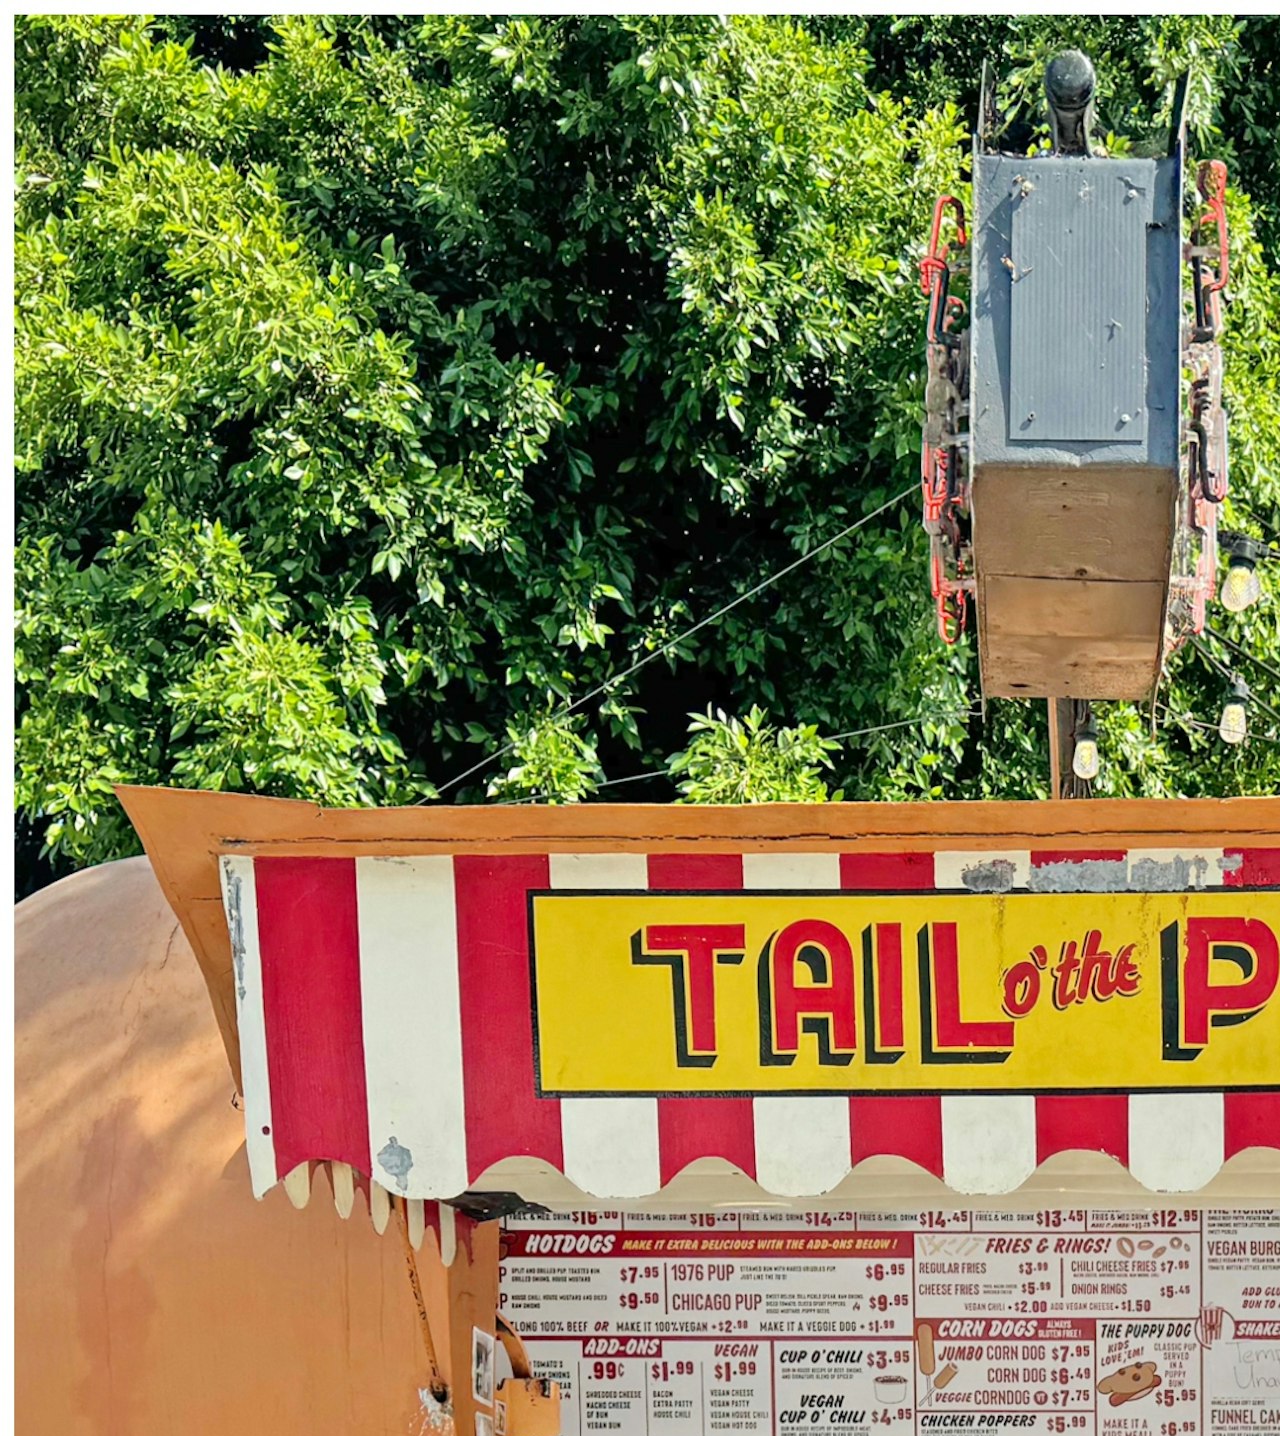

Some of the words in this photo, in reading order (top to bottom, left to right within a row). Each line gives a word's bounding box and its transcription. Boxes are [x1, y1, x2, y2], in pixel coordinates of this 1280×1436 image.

[631, 919, 1014, 1068] TAIL
[920, 1211, 968, 1228] $14.45
[1037, 1211, 1083, 1227] $13.45
[1153, 1210, 1198, 1227] $12.95
[525, 1234, 616, 1254] HOTDOGS
[623, 1240, 652, 1250] MAKE
[654, 1240, 665, 1249] IT
[667, 1240, 698, 1250] EXTRA
[701, 1240, 755, 1250] DELICIOUS
[757, 1240, 783, 1250] WITH
[787, 1240, 805, 1250] THE
[806, 1240, 851, 1250] ADD-ONS
[855, 1240, 890, 1250] BELOW
[985, 1238, 1032, 1254] FRIES
[1037, 1238, 1049, 1253] &
[1053, 1238, 1111, 1254] RINGS!
[1207, 1241, 1246, 1256] VEGAN
[672, 1264, 704, 1281] 1976
[709, 1264, 734, 1281] PUP
[866, 1264, 905, 1281] $6.95
[919, 1263, 960, 1274] REGULAR
[962, 1263, 986, 1274] FRIES
[1071, 1261, 1093, 1273] CHILI
[1096, 1261, 1129, 1272] CHEESE
[1131, 1261, 1157, 1272] FRIES
[620, 1266, 659, 1284] $7.95
[919, 1284, 952, 1295] CHEESE
[954, 1284, 980, 1295] FRIES
[1071, 1284, 1098, 1295] ONION
[1101, 1284, 1127, 1295] RINGS
[1242, 1287, 1262, 1296] ADD
[619, 1293, 659, 1310] $9.50
[672, 1294, 731, 1311] CHICAGO
[735, 1294, 762, 1310] PUP
[869, 1294, 909, 1312] $9.95
[1066, 1302, 1087, 1311] VEGAN
[1121, 1300, 1151, 1312] $1.50
[1242, 1300, 1262, 1309] BUN
[1264, 1300, 1275, 1309] TO
[540, 1322, 564, 1332] 100%
[567, 1322, 588, 1332] BEEF
[594, 1321, 609, 1332] OR
[617, 1322, 642, 1332] MAKE
[643, 1322, 652, 1332] IT
[760, 1321, 785, 1332] MAKE
[787, 1321, 795, 1332] IT
[798, 1322, 803, 1332] A
[807, 1321, 837, 1332] VEGGIE
[840, 1321, 856, 1332] DOG
[938, 1320, 985, 1338] CORN
[989, 1320, 1038, 1338] DOGS
[1046, 1320, 1072, 1329] ALWAYS
[1101, 1324, 1123, 1338] THE
[1125, 1324, 1164, 1338] PUPPY
[1166, 1324, 1191, 1338] DOG
[584, 1339, 660, 1355] ADD-ONS
[714, 1344, 759, 1357] VEGAN
[938, 1346, 983, 1361] JUMBO
[986, 1345, 1020, 1361] CORN
[1022, 1345, 1046, 1360] DOG
[1052, 1345, 1090, 1363] $7.95
[1108, 1340, 1130, 1353] KIDS
[1154, 1343, 1181, 1351] CLASSIC
[1184, 1343, 1197, 1351] PUP
[780, 1351, 807, 1363] CUP
[867, 1350, 910, 1369] $3.95
[1163, 1352, 1189, 1360] SERVED
[652, 1362, 694, 1381] $1.99
[714, 1361, 756, 1382] $1.99
[987, 1368, 1019, 1383] CORN
[1023, 1368, 1046, 1382] DOG
[1051, 1368, 1091, 1385] $6.49
[1165, 1371, 1186, 1379] PUPPY
[586, 1391, 617, 1399] SHREDDED
[732, 1389, 754, 1397] CHEESE
[935, 1393, 972, 1403] VEGGIE
[974, 1390, 1030, 1405] CORNDOG
[1052, 1390, 1090, 1407] $7.75
[1155, 1390, 1196, 1407] $5.95
[800, 1395, 845, 1408] VEGAN
[779, 1410, 807, 1424] CUP
[830, 1411, 866, 1423] CHILI
[871, 1408, 912, 1425] $4.95
[921, 1415, 974, 1427] CHICKEN
[978, 1415, 1037, 1427] POPPERS
[1047, 1416, 1086, 1433] $5.99
[1103, 1419, 1129, 1429] MAKE
[1132, 1419, 1140, 1429] IT
[1142, 1419, 1148, 1429] A
[1211, 1410, 1256, 1424] FUNNEL
[1161, 1421, 1196, 1436] $6.95
